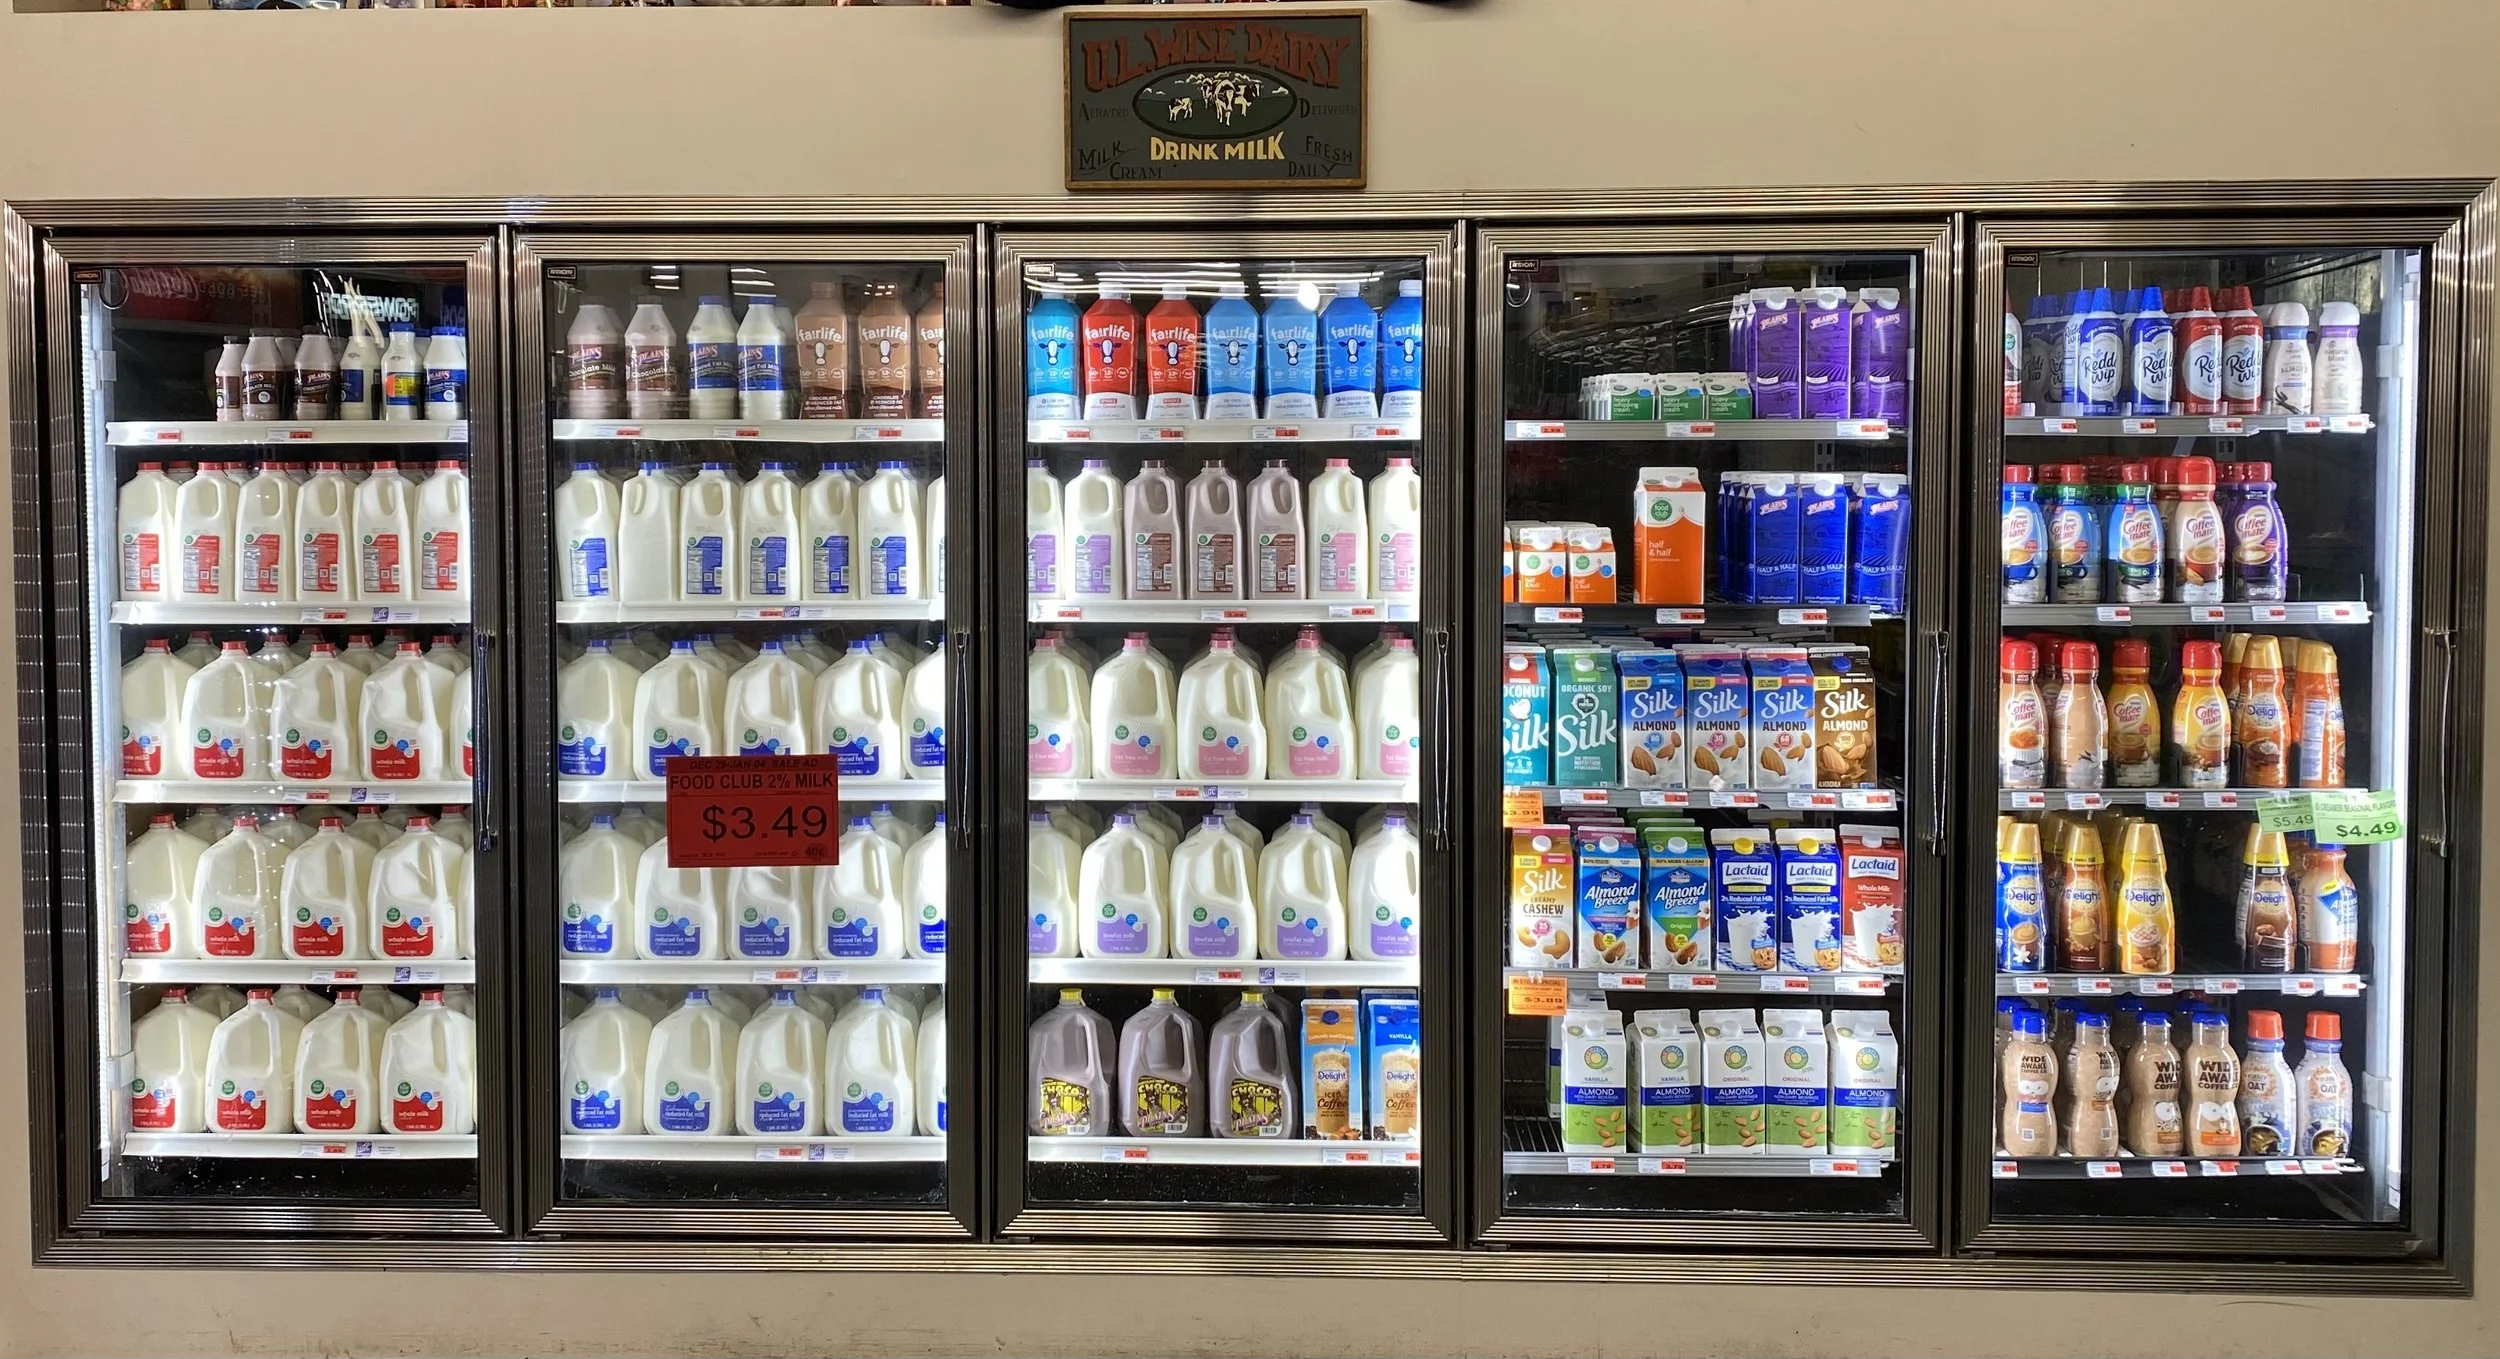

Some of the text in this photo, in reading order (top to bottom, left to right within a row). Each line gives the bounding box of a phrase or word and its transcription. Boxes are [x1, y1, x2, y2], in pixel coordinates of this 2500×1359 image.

[1081, 22, 1351, 93] U.L. WISE DAIRY
[1150, 131, 1285, 161] DRINK MILK
[1305, 135, 1353, 164] FRESH
[1078, 140, 1126, 171] MILK
[1110, 162, 1162, 180] CREAM
[1288, 161, 1338, 178] DAILY
[2092, 368, 2115, 384] wip
[2123, 520, 2152, 535] Coffee
[2186, 518, 2216, 533] Coffee
[2241, 526, 2265, 538] mate
[2129, 530, 2150, 539] mate
[2193, 527, 2215, 538] mate
[1649, 540, 1664, 549] half
[1656, 548, 1672, 556] half
[1561, 684, 1612, 692] ORGANIC SOY
[1631, 689, 1678, 718] Silk
[1694, 689, 1742, 718] Silk
[1761, 689, 1808, 718] Silk
[1821, 689, 1869, 718] Silk
[2007, 700, 2036, 714] Coffee
[2014, 712, 2035, 721] mate
[2119, 713, 2140, 723] mate
[1633, 720, 1676, 731] ALMOND
[1696, 720, 1740, 731] ALMOND
[1763, 720, 1806, 731] ALMOND
[1823, 720, 1868, 731] ALMOND
[1557, 710, 1617, 757] Silk
[670, 772, 833, 790] FOOD CLUB 2% MILK
[2344, 803, 2371, 812] SEASONAL
[702, 804, 828, 843] $3.49
[2336, 822, 2396, 838] $4.49
[1725, 864, 1769, 877] Lactaid
[1789, 864, 1834, 877] Lactaid
[1851, 857, 1896, 871] Lactaid
[1519, 869, 1567, 897] Silk
[1584, 883, 1637, 900] Almond
[1654, 883, 1707, 900] Almond
[1594, 896, 1628, 909] Breeze
[1665, 896, 1699, 909] Breeze
[1523, 904, 1564, 915] CASHEW
[1670, 923, 1692, 931] Original
[1317, 1071, 1347, 1083] Delight
[1386, 1071, 1416, 1083] Delight
[1042, 1084, 1080, 1097] CHOCO
[1138, 1083, 1178, 1096] CHOCO
[1231, 1085, 1272, 1098] CHOCO
[1719, 1088, 1754, 1096] ALMOND
[1778, 1088, 1815, 1096] ALMOND
[1849, 1089, 1886, 1097] ALMOND
[2247, 1082, 2266, 1091] OAT
[2320, 1084, 2338, 1093] OAT
[1317, 1099, 1347, 1110] Coffee
[1386, 1099, 1416, 1110] Coffee
